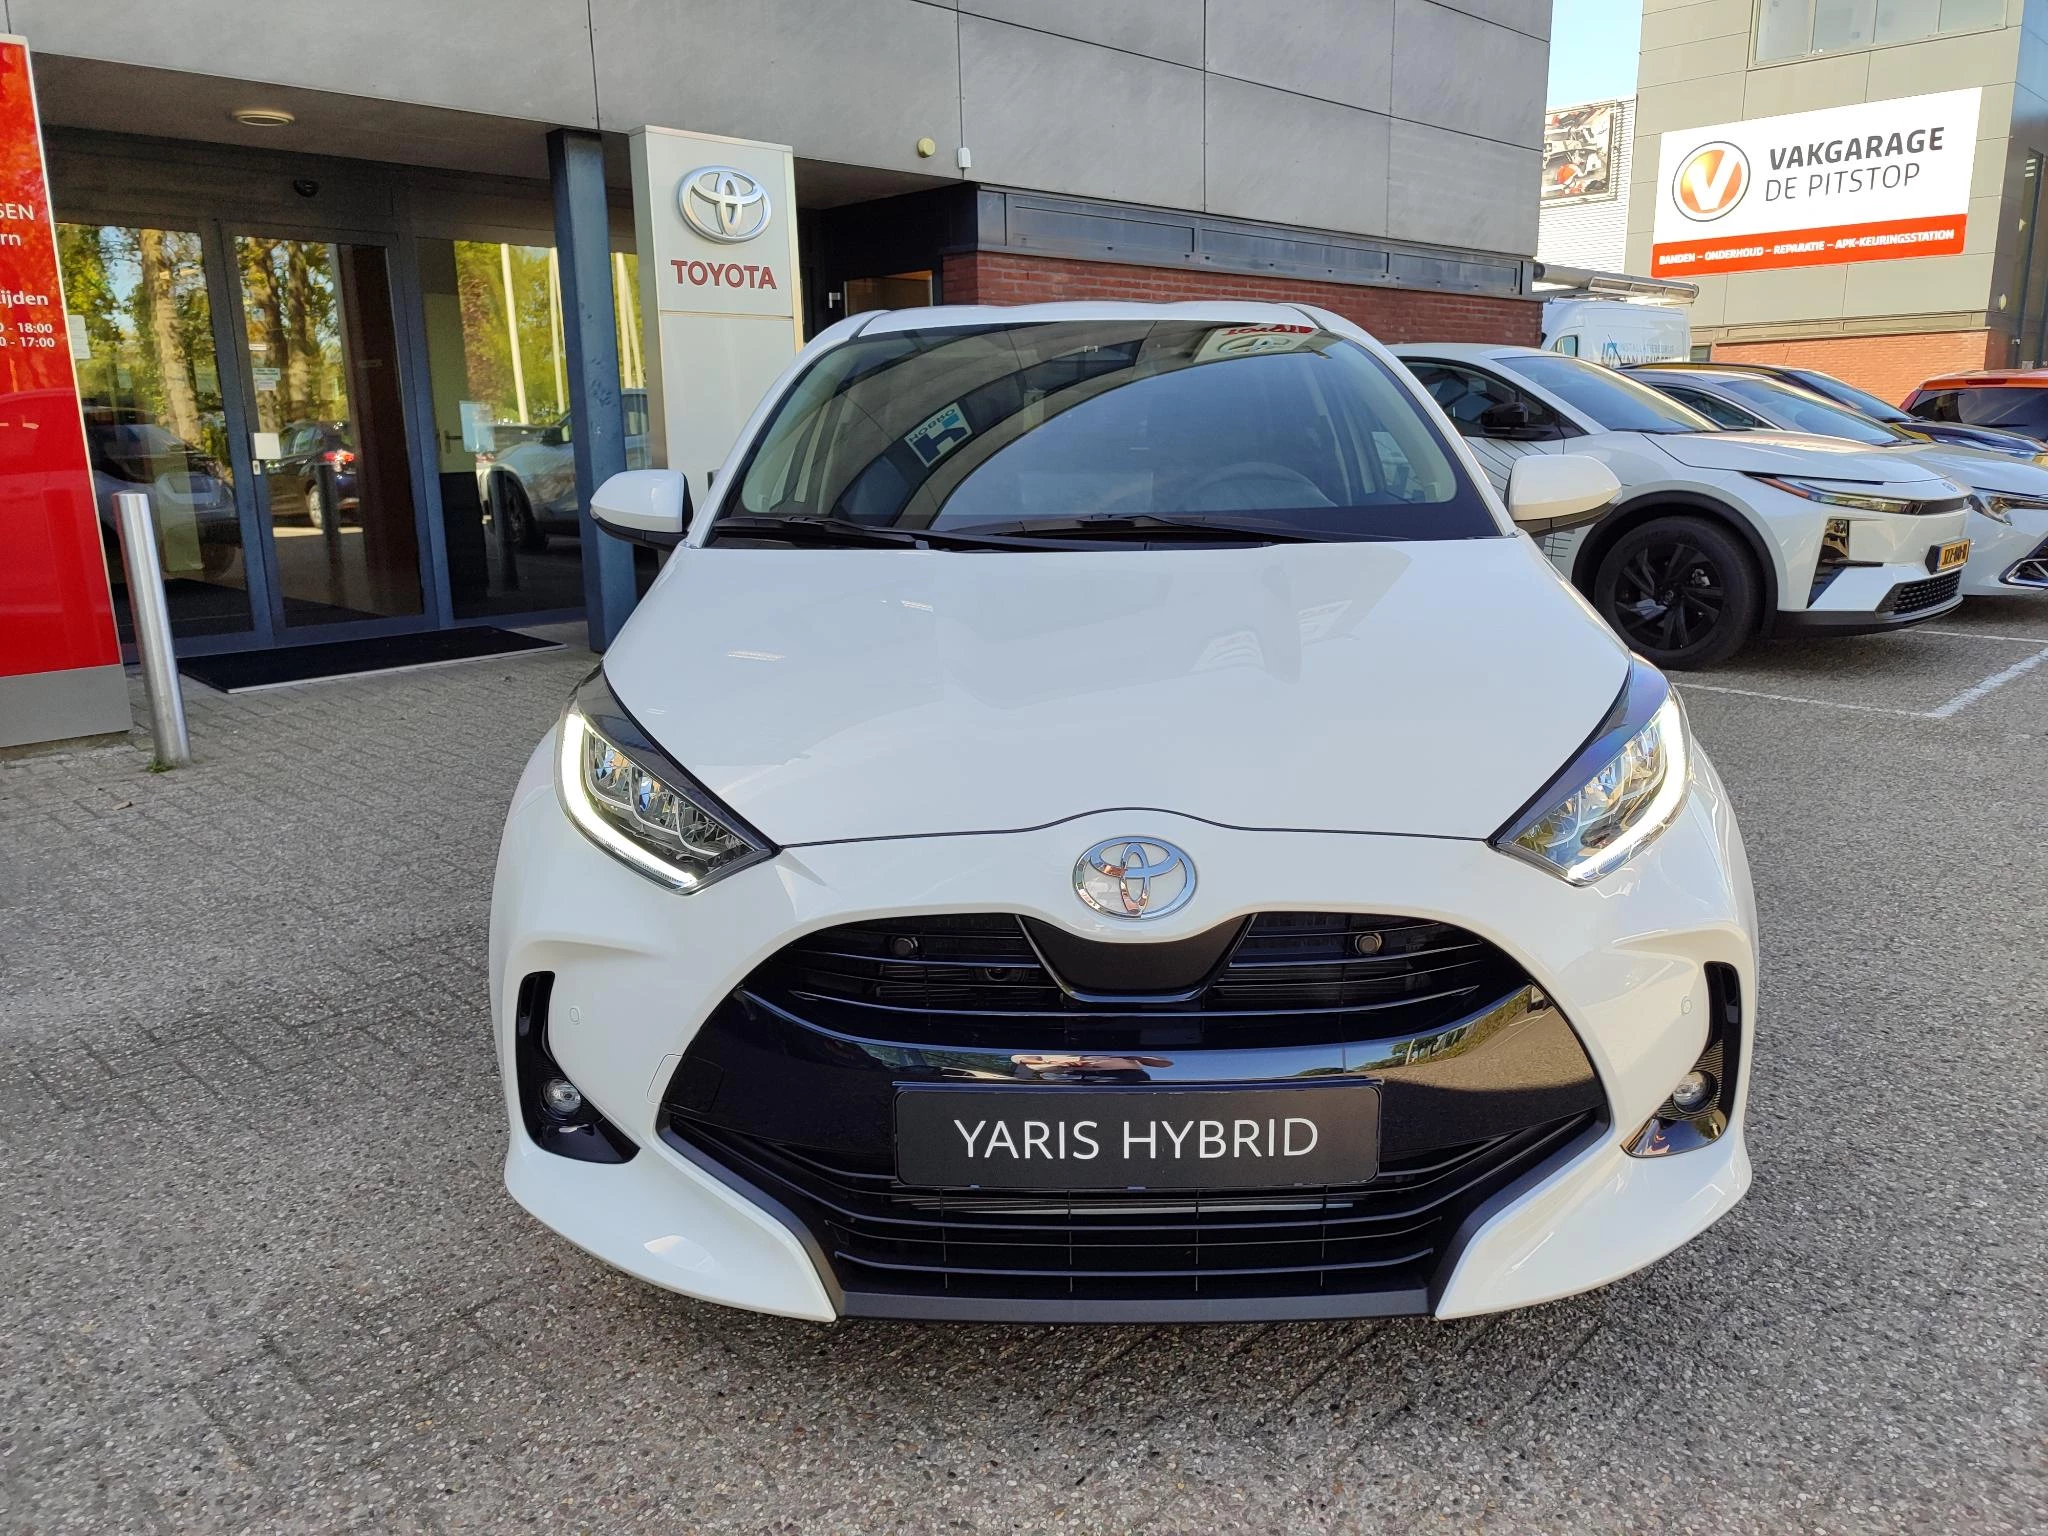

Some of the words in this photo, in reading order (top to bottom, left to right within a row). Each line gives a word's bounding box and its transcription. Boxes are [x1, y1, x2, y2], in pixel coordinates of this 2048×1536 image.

[1769, 127, 1945, 171] VAKGARAGE
[1765, 177, 1798, 202] DE
[1808, 162, 1920, 198] PITSTOP
[1659, 252, 1696, 265] BANDEN
[1704, 246, 1764, 261] ONDERHOUD
[1773, 240, 1826, 255] REPARATIE
[1834, 229, 1955, 250] APK-KEURINGSSTATION
[670, 259, 777, 290] TOYOTA
[0, 290, 49, 309] ijden
[17, 322, 53, 334] 18:00
[19, 336, 55, 348] 17:00
[953, 1119, 1100, 1160] YARIS
[1122, 1117, 1319, 1159] HYBRID
